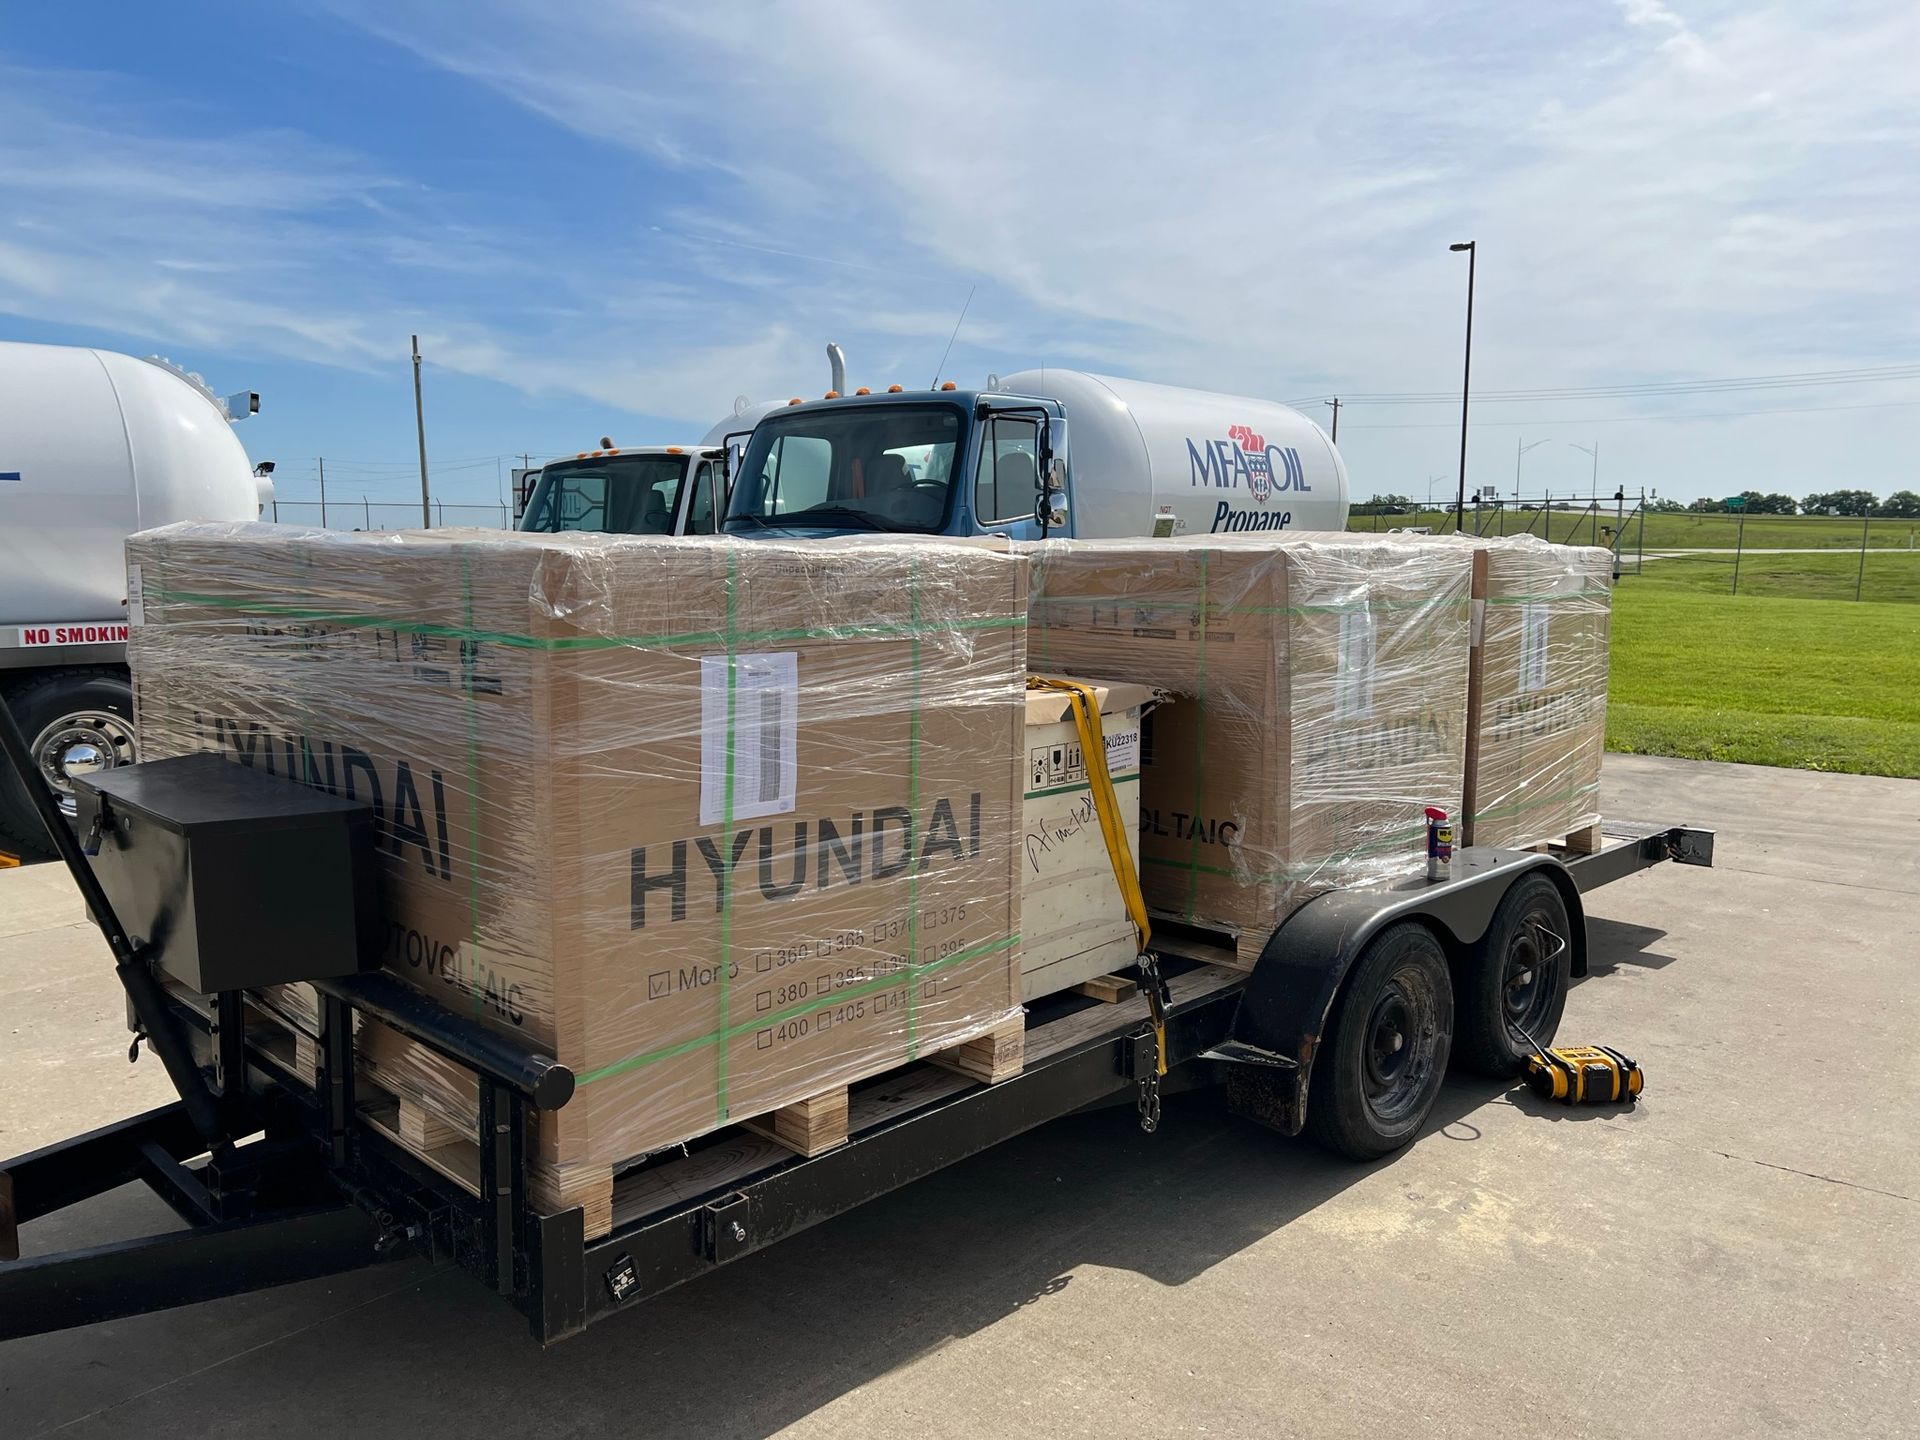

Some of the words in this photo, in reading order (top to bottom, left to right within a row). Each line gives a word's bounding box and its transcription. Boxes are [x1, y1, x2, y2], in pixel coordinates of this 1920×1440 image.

[1186, 438, 1252, 489] MFA
[1265, 444, 1312, 492] OIL
[1211, 501, 1291, 534] Propane
[24, 629, 50, 645] NO
[55, 626, 129, 644] SMOKIN
[1106, 733, 1138, 750] KU22318
[630, 792, 981, 931] HYUNDAI
[679, 962, 739, 991] Mono
[776, 943, 808, 967] 360
[836, 932, 865, 952] 365
[940, 904, 966, 926] 375
[776, 981, 808, 1005] 380
[836, 966, 865, 989] 385
[940, 938, 966, 959] 395
[776, 1019, 809, 1042] 400
[836, 1002, 865, 1025] 405
